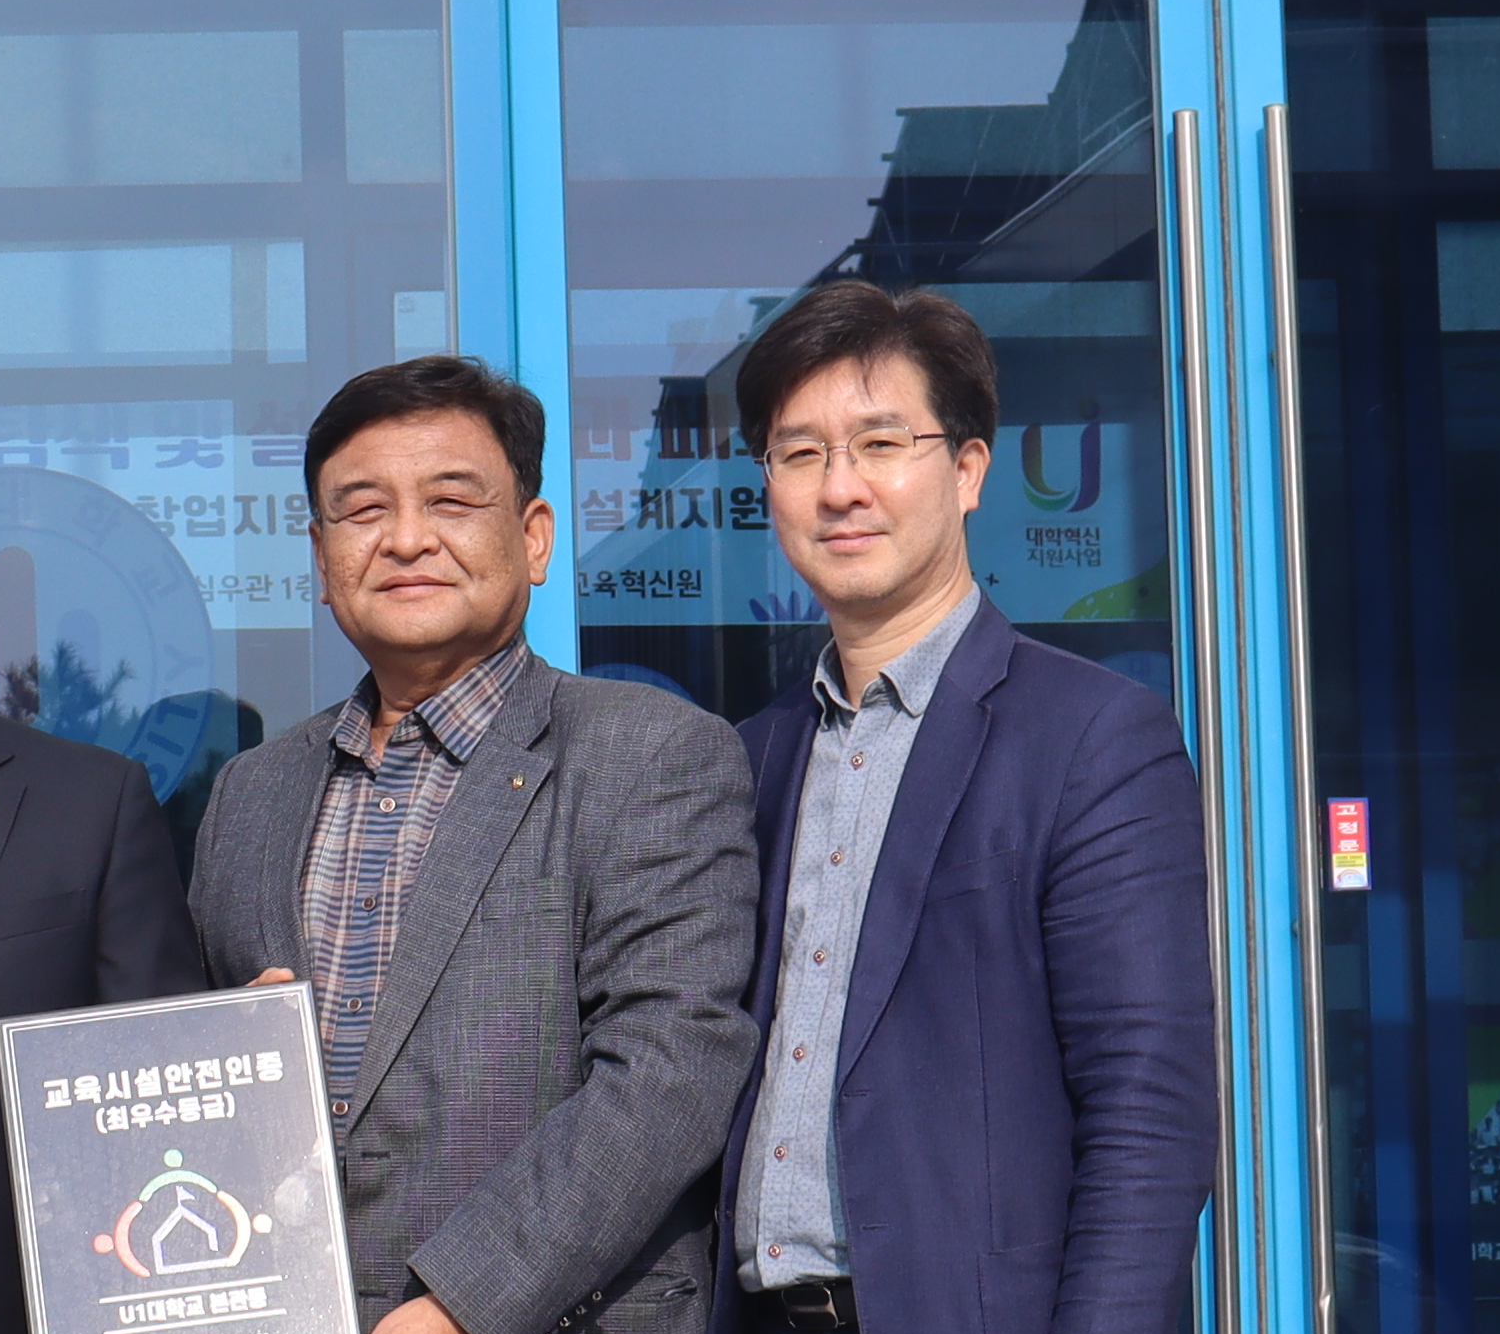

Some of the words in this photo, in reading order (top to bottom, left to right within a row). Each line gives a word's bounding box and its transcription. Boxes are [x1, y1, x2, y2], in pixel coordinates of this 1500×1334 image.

[1026, 526, 1101, 547] 대학혁신
[1026, 548, 1102, 568] 지원사업
[1335, 804, 1360, 853] 고정문
[42, 1050, 284, 1109] 교육시설안전인증
[95, 1091, 237, 1134] (최우수등급)
[118, 1295, 206, 1324] U1대학교
